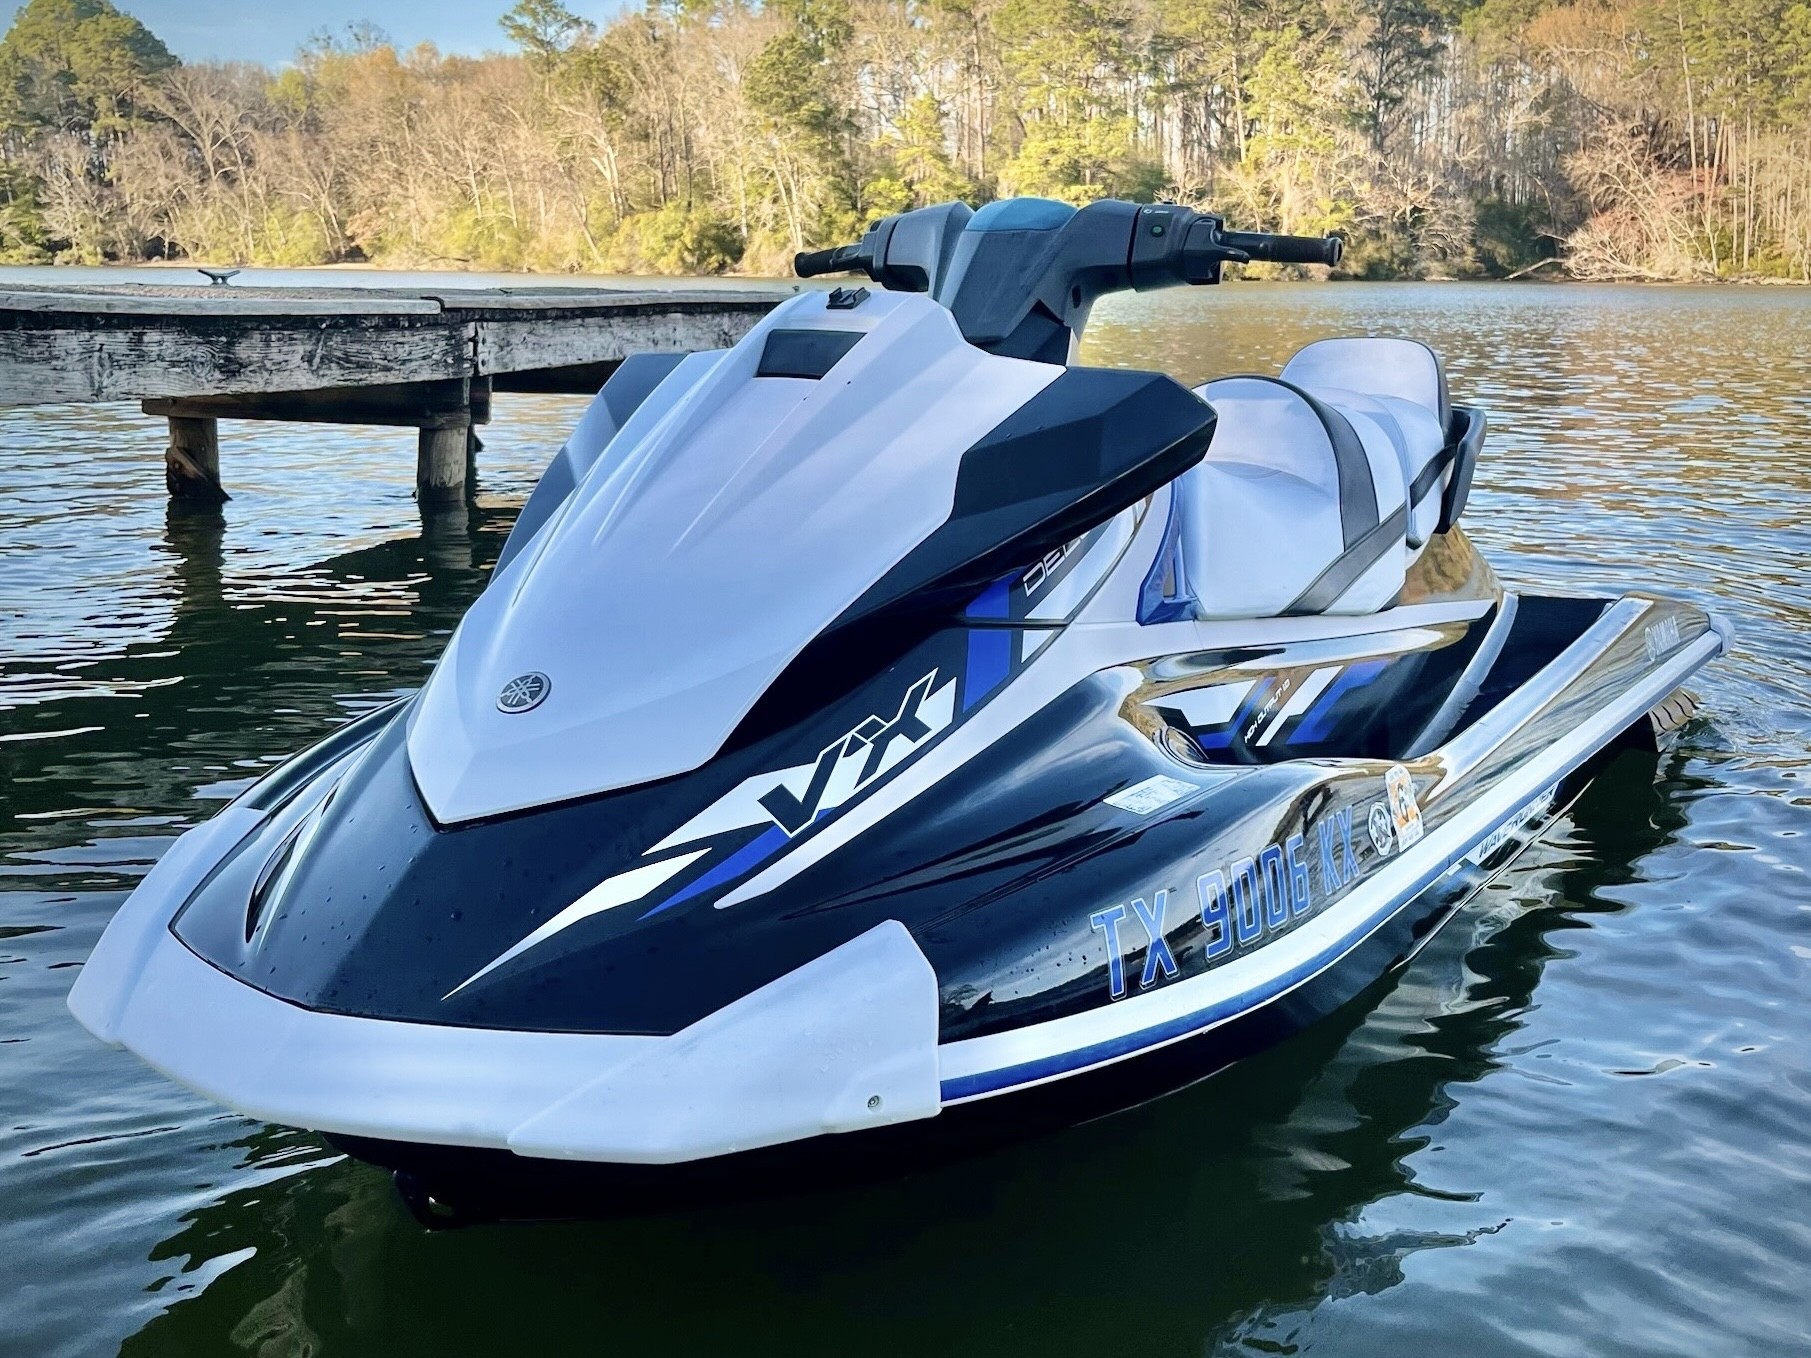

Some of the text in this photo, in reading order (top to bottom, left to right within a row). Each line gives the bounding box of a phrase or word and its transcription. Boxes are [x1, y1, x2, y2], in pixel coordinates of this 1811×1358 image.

[756, 667, 939, 838] VX
[1089, 805, 1361, 1000] TX 9006 KX
